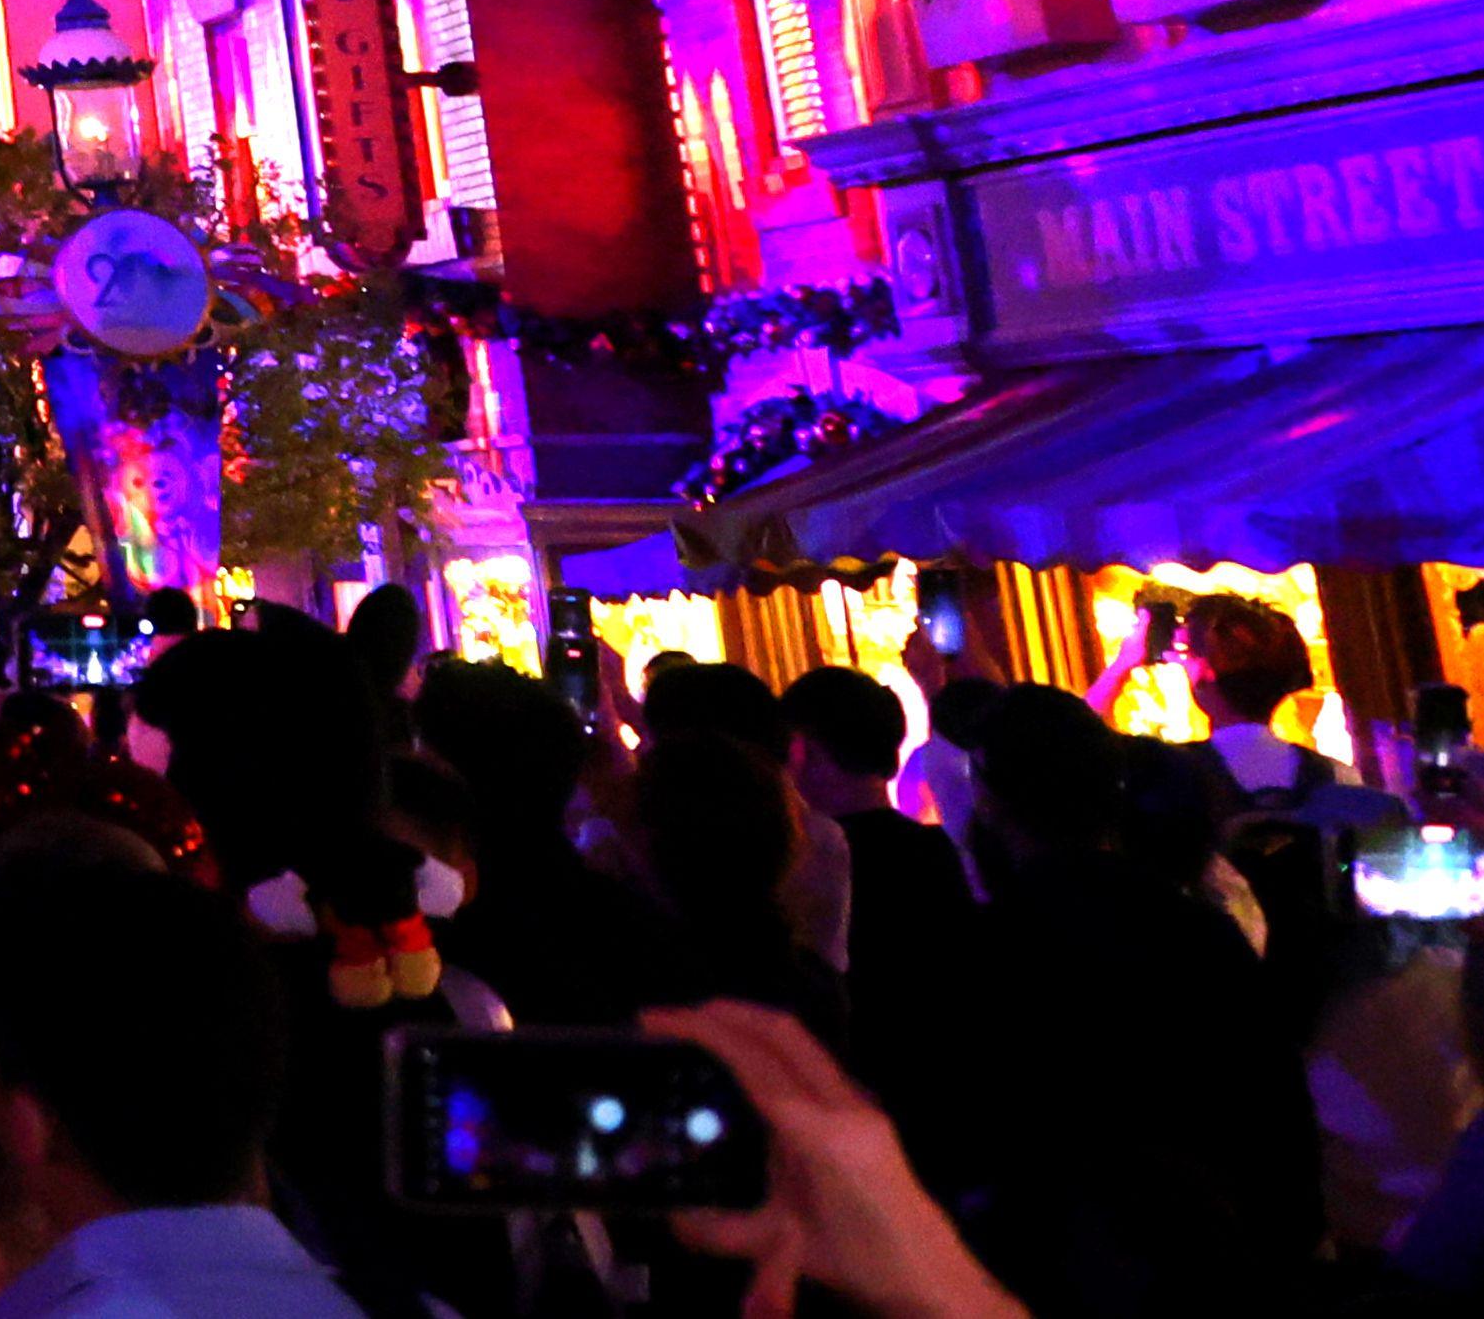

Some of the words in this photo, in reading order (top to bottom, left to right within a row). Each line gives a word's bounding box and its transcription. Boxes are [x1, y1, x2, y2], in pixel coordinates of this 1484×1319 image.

[335, 30, 389, 199] GIFTS
[1037, 185, 1200, 285] MAIN
[1212, 136, 1484, 263] STREET
